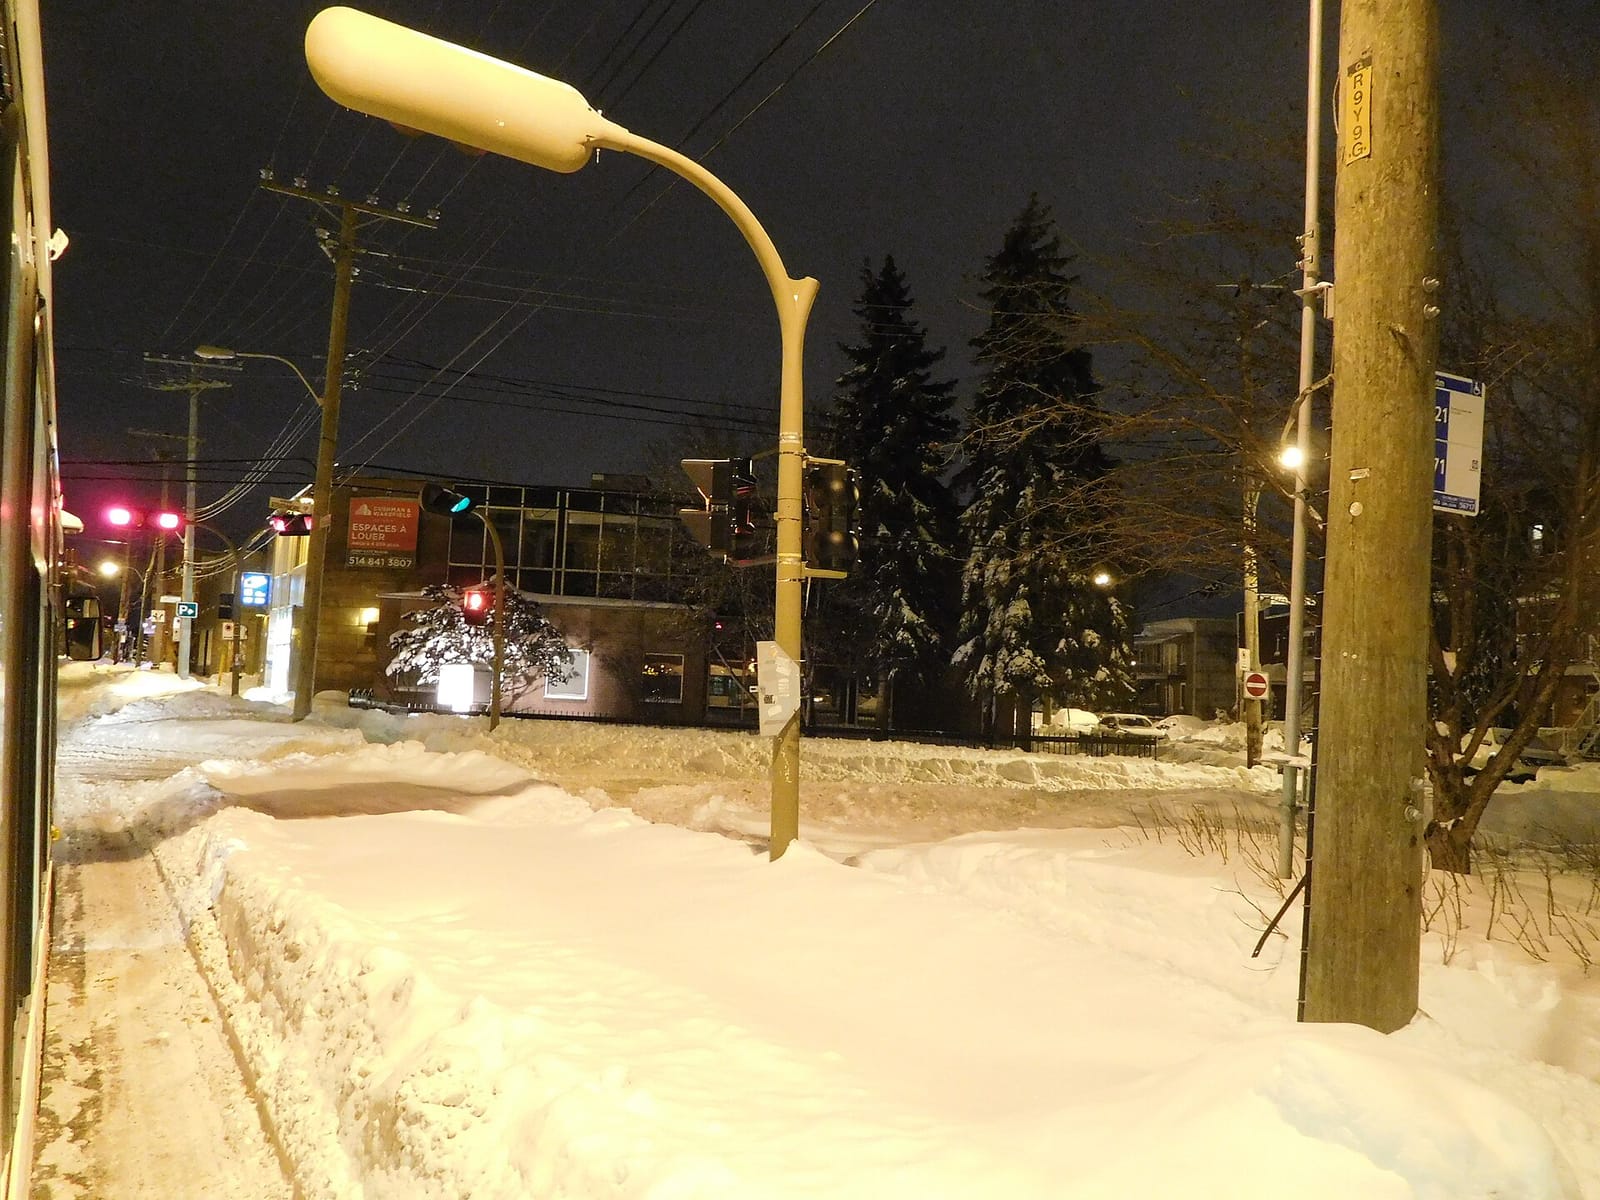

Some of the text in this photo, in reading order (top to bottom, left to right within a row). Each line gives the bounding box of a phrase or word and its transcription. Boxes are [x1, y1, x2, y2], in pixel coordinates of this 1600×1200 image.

[1351, 73, 1364, 158] R9Y9G
[352, 523, 397, 533] ESPACES
[351, 531, 385, 541] LOUER
[348, 556, 413, 567] 514 841 3807
[179, 605, 188, 615] P
